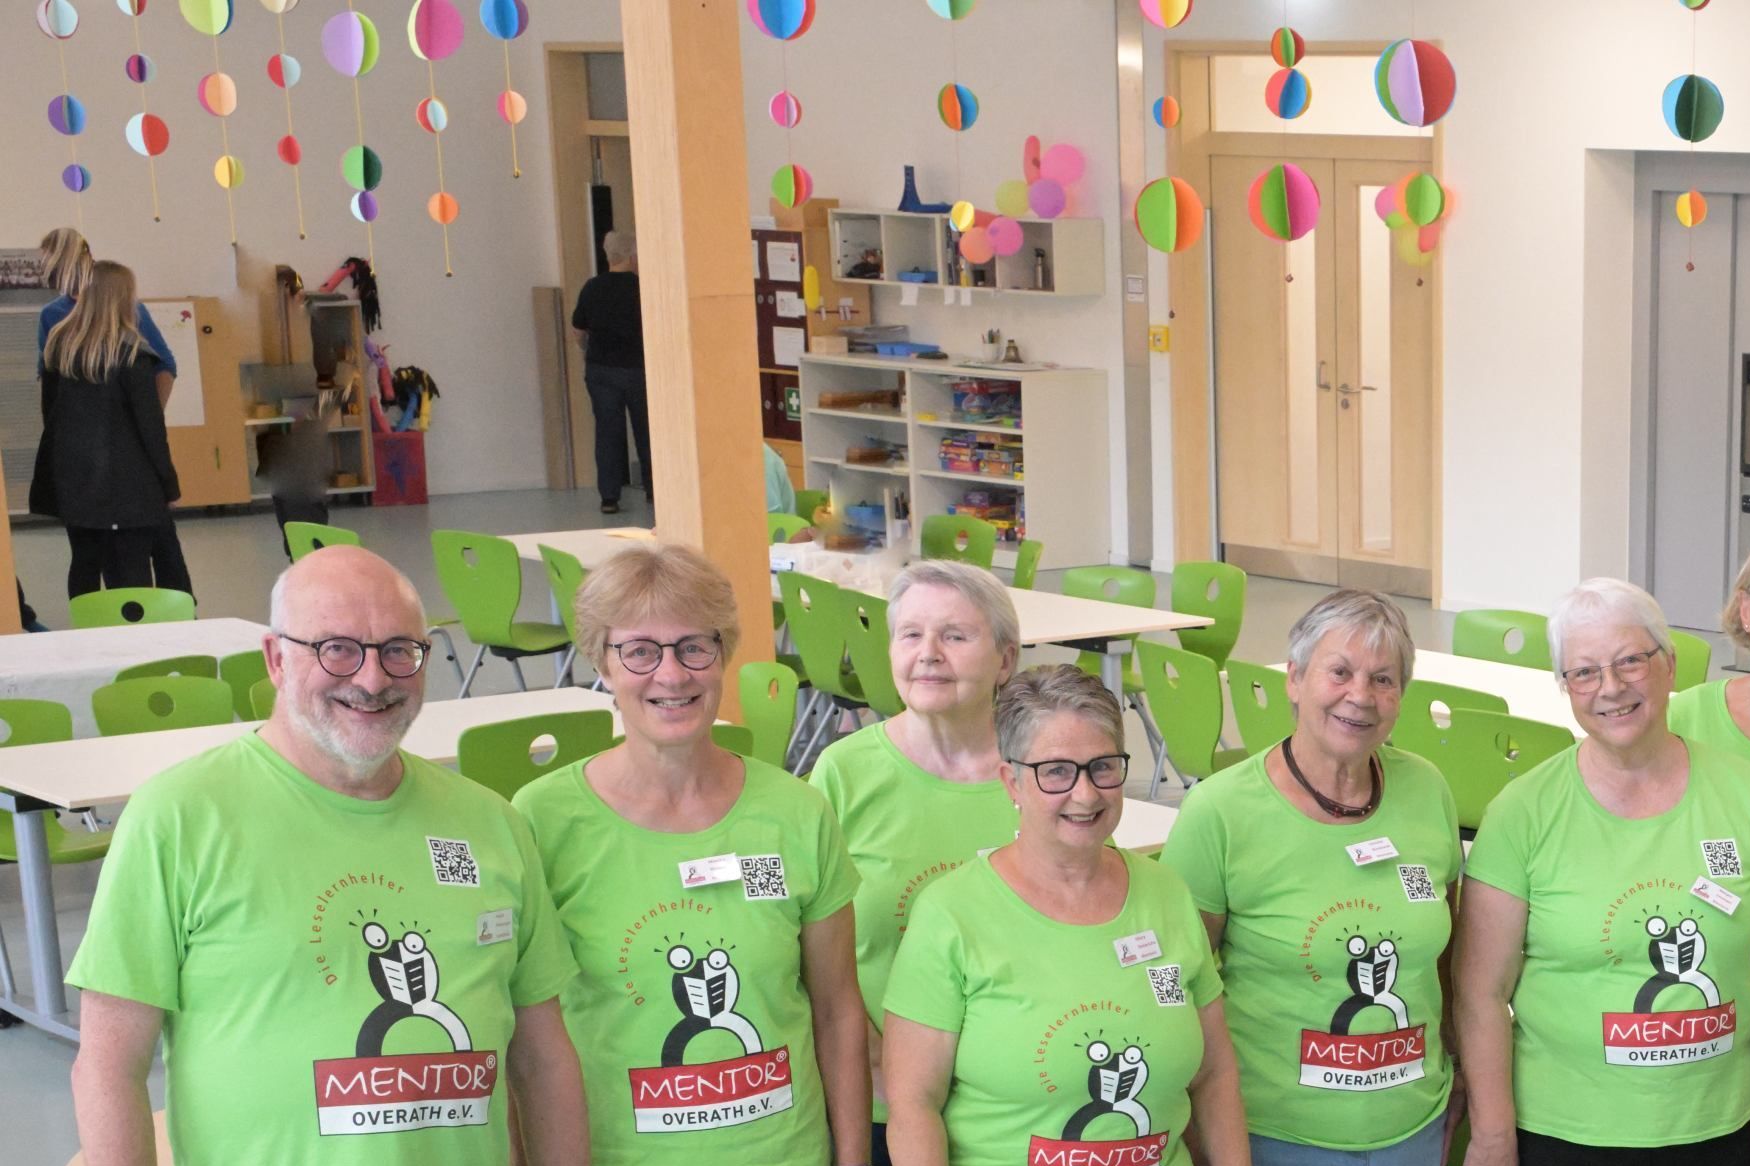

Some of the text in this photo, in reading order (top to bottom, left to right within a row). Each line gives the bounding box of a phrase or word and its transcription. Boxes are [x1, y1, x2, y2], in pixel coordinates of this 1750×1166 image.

[309, 872, 404, 944] Leselernhelfer
[894, 858, 963, 917] Leselernhe
[1600, 878, 1683, 942] Leselernhelfer
[617, 898, 712, 973] Leselernhelfer
[1299, 897, 1382, 957] Leselernhelfer
[1033, 999, 1129, 1063] Leselernhelfer
[1628, 1047, 1697, 1061] OVERATH
[1323, 1071, 1387, 1086] OVERATH
[352, 1106, 442, 1126] OVERATH
[662, 1105, 743, 1125] OVERATH
